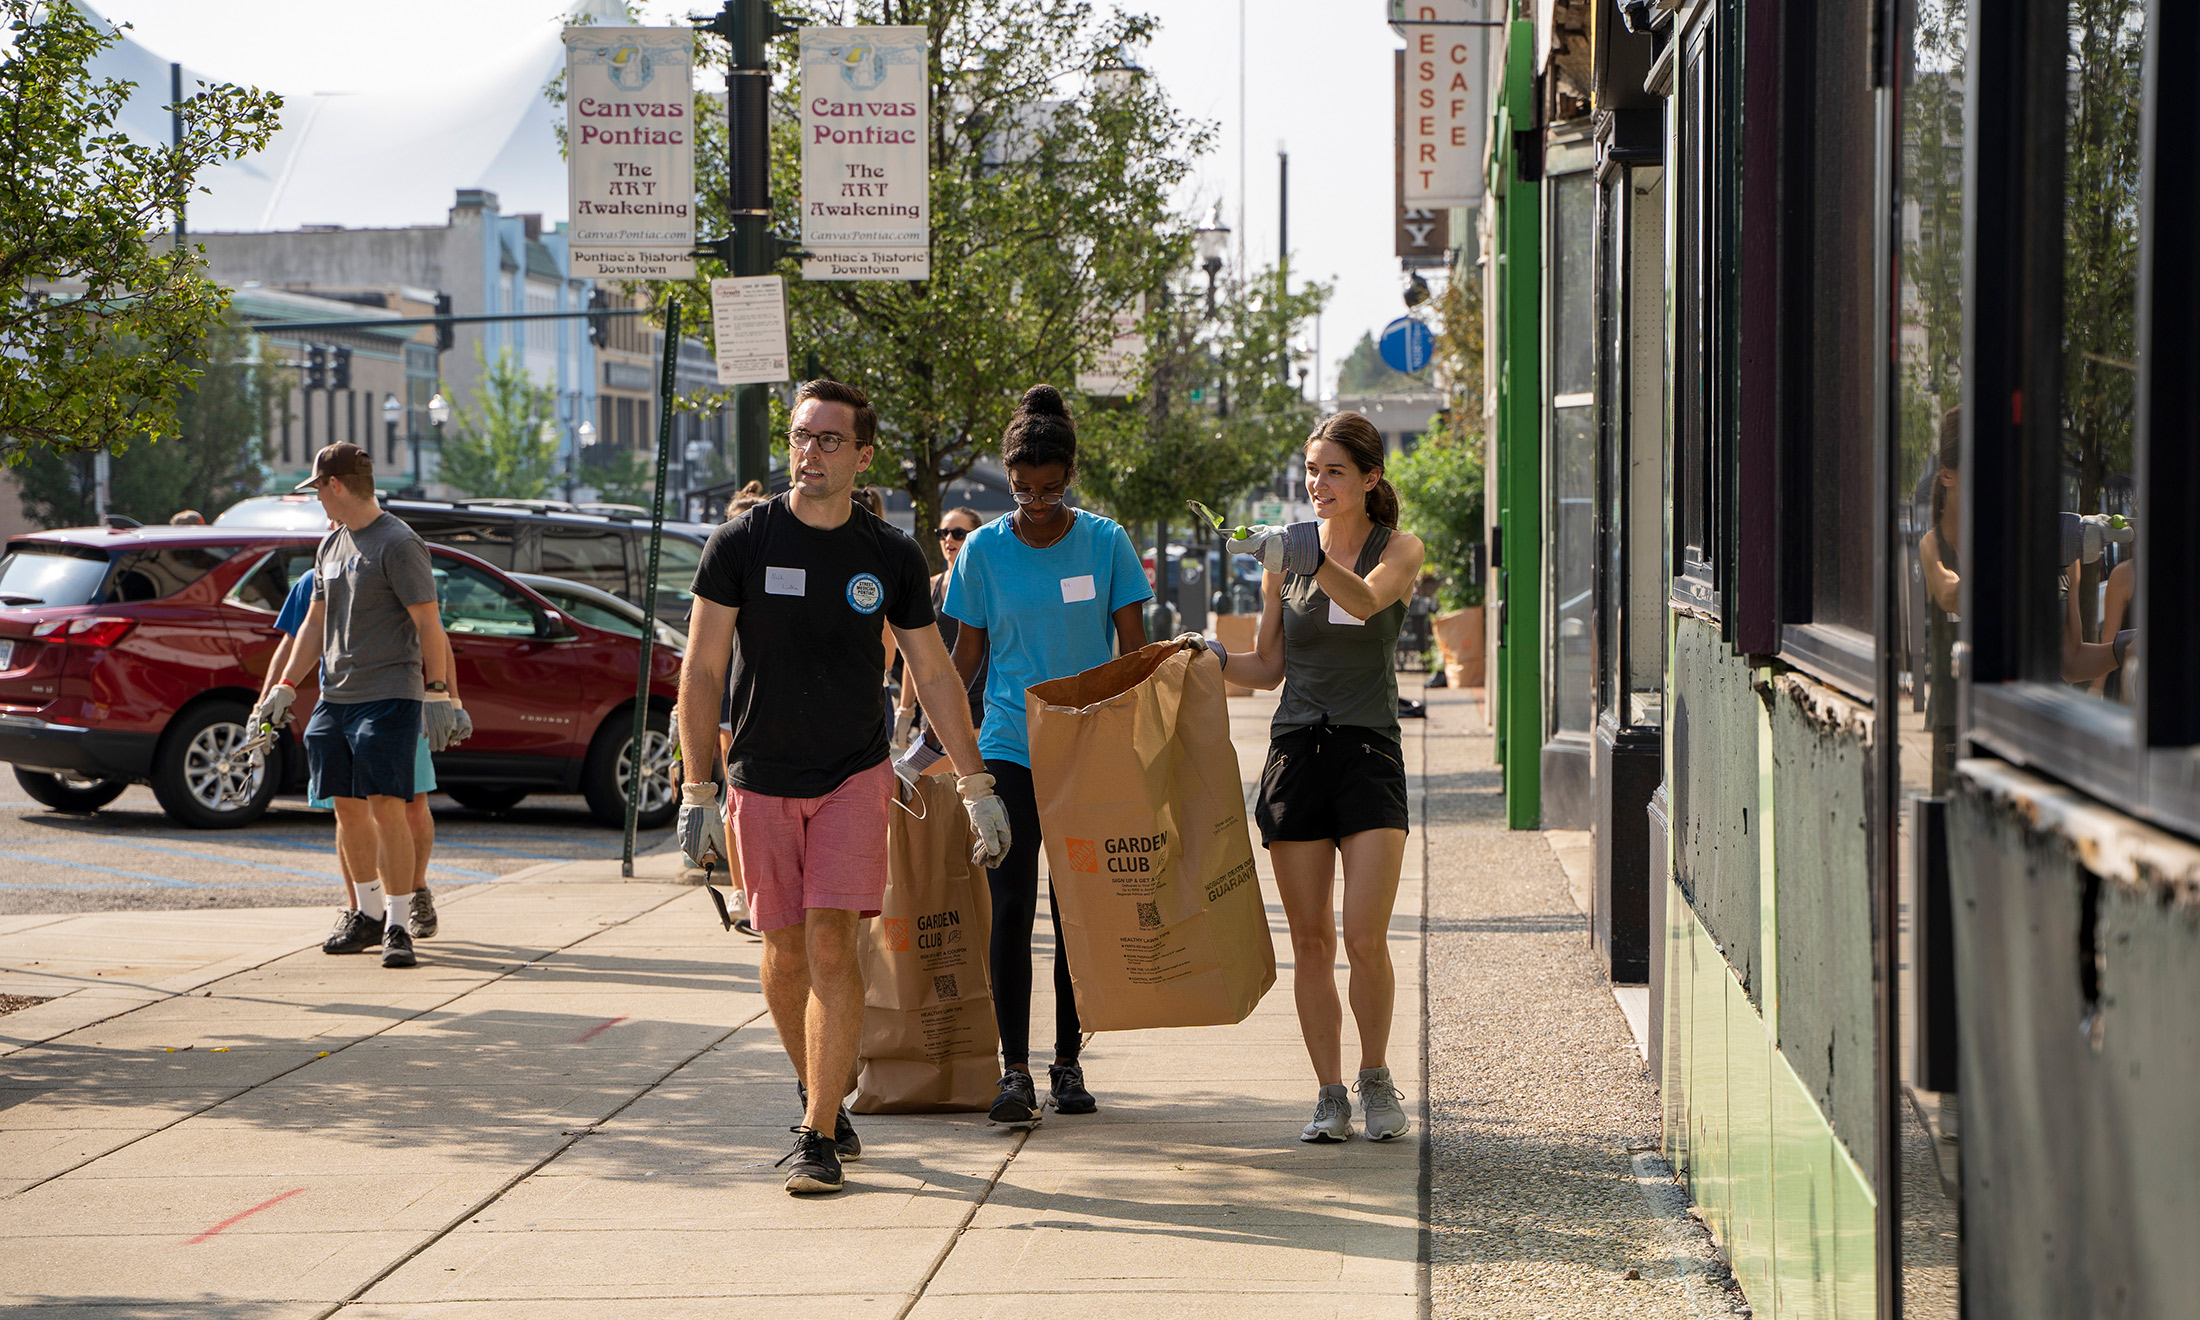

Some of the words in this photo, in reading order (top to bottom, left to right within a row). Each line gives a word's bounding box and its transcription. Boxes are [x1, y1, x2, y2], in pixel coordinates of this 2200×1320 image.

[1419, 7, 1437, 190] DESSERT
[1450, 44, 1468, 147] CAFE
[579, 97, 684, 117] Canvas
[812, 97, 916, 117] Canvas
[580, 125, 683, 145] Pontiac
[813, 124, 916, 145] Pontiac
[613, 162, 652, 176] The
[845, 164, 884, 178] The
[609, 181, 656, 196] ART
[841, 183, 888, 197] ART
[578, 200, 687, 217] Awakening
[810, 202, 920, 219] Awakening
[577, 229, 687, 240] CanvasPontiac.com
[810, 231, 920, 241] CanvasPontiac.com
[575, 251, 636, 262] Pontiac's
[638, 251, 692, 264] Historic
[598, 263, 667, 274] Downtown
[831, 264, 899, 275] Downtown
[1104, 830, 1168, 854] GARDEN
[1107, 857, 1150, 873] CLUB
[1205, 874, 1227, 892] NOBODY
[1227, 863, 1244, 878] BEATS
[917, 910, 960, 931] GARDEN
[918, 932, 942, 949] CLUB
